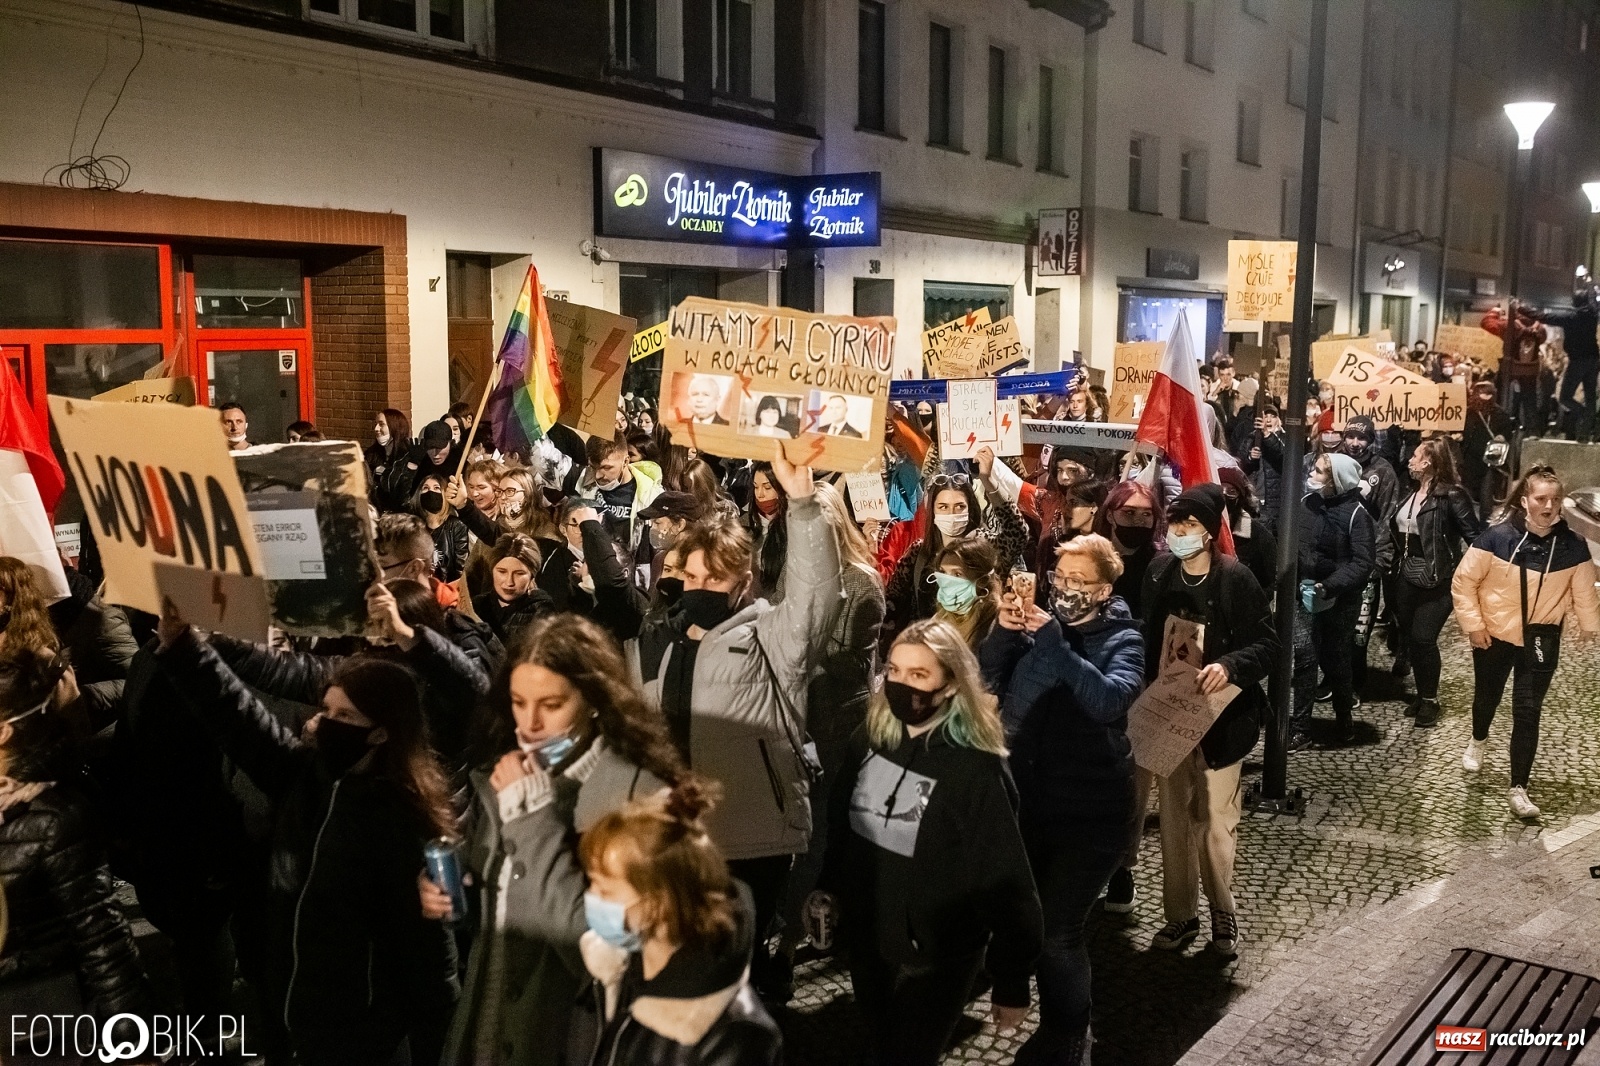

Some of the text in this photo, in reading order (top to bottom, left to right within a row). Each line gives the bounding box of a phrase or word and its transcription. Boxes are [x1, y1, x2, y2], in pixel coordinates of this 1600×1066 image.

[664, 172, 793, 227] Jubiler Złotnik
[809, 187, 864, 214] Jubiler
[681, 217, 724, 234] OCZADŁY
[809, 215, 865, 239] Złotnik
[670, 309, 761, 346] WITAMY
[773, 317, 794, 356] W
[685, 350, 889, 397] W ROLACH GŁÓWNYCH
[952, 381, 992, 397] STRACH
[951, 411, 993, 431] RUCHAĆ
[854, 499, 878, 512] CIPKI
[275, 523, 302, 532] ERROR
[1167, 693, 1202, 715] BOSAK
[1166, 723, 1203, 741] GODEK
